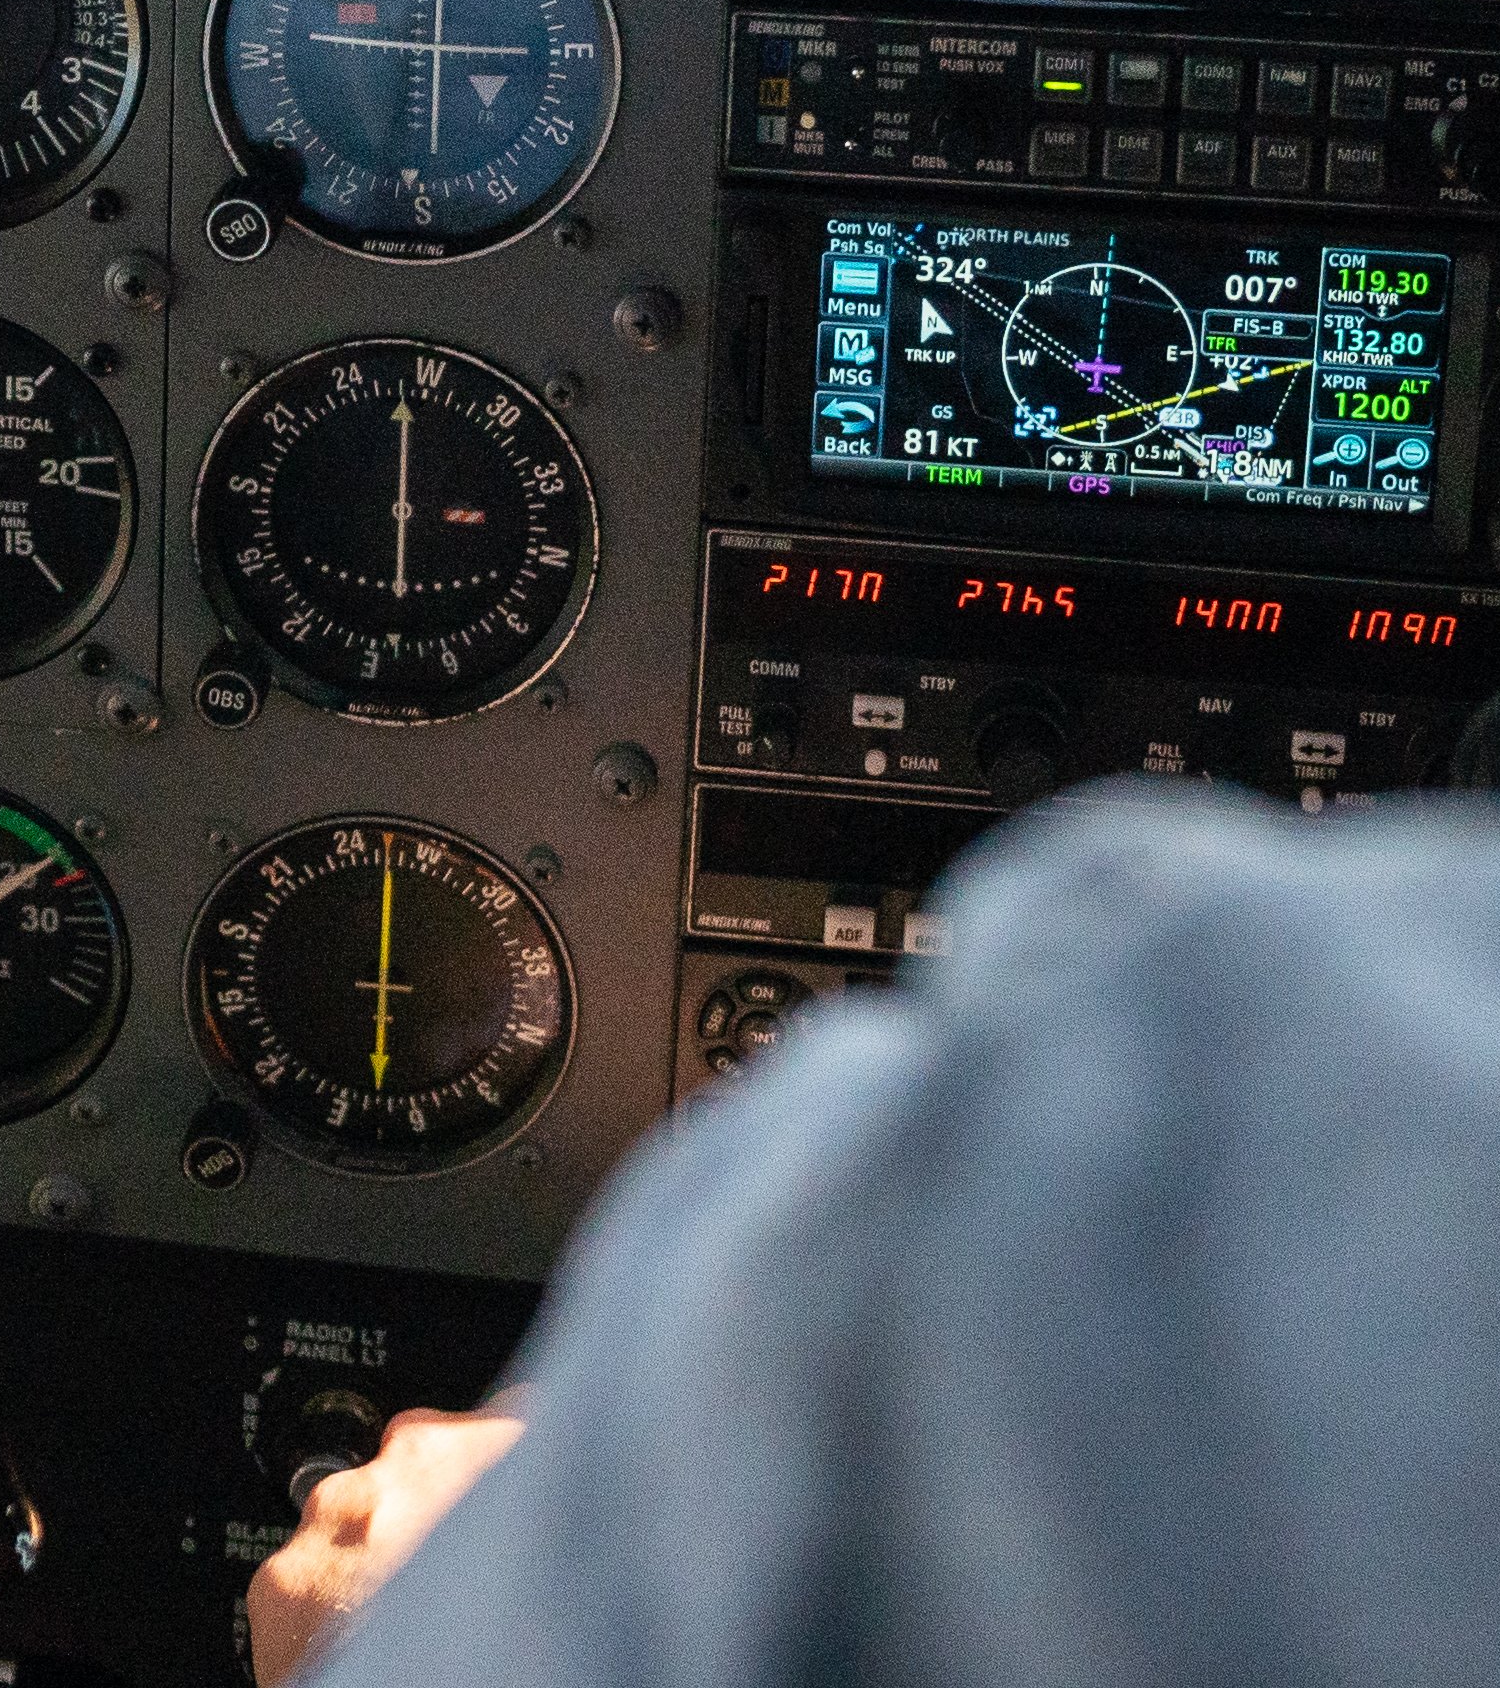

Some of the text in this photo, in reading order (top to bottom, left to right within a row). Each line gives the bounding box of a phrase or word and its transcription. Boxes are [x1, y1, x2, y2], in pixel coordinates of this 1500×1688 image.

[930, 38, 1018, 57] INTERCOM
[940, 57, 1006, 74] PUSH VOX
[1046, 56, 1086, 72] COM1
[1404, 59, 1437, 78] MIC
[1344, 72, 1383, 88] NAV2
[1446, 77, 1467, 92] C1
[1480, 72, 1500, 88] C2
[826, 218, 891, 237] Com Vol
[830, 237, 859, 253] Psh
[1012, 231, 1070, 248] PLAINS
[1246, 249, 1280, 266] TRK
[1328, 254, 1366, 268] COM
[915, 256, 1298, 304] 324° 007°
[1338, 270, 1430, 296] 119.30
[1328, 290, 1400, 306] KHIO TWR
[826, 298, 882, 318] Menu
[1324, 315, 1365, 330] STBY
[1206, 337, 1237, 351] TFR
[1333, 330, 1424, 356] 132.80
[904, 349, 957, 364] TRK UP
[1322, 352, 1394, 366] KHIO TWR
[331, 362, 364, 392] 24
[828, 368, 873, 387] MSG
[1322, 375, 1431, 394] XPDR ALT
[4, 374, 35, 402] 15
[486, 394, 522, 430] 30
[931, 405, 954, 420] GS
[1334, 392, 1412, 423] 1200
[824, 436, 872, 456] Back
[903, 428, 980, 458] 81 KT
[38, 458, 81, 486] 20
[926, 465, 983, 486] TERM
[1068, 476, 1111, 495] GPS
[1328, 472, 1419, 492] In Out
[1246, 488, 1280, 505] Com
[1338, 492, 1368, 508] Psh
[1372, 496, 1404, 511] Nav
[749, 659, 956, 692] COMM STBY
[208, 686, 246, 712] OBS
[1198, 696, 1396, 728] NAV STBY
[899, 755, 940, 773] CHAN
[20, 904, 60, 933] 30
